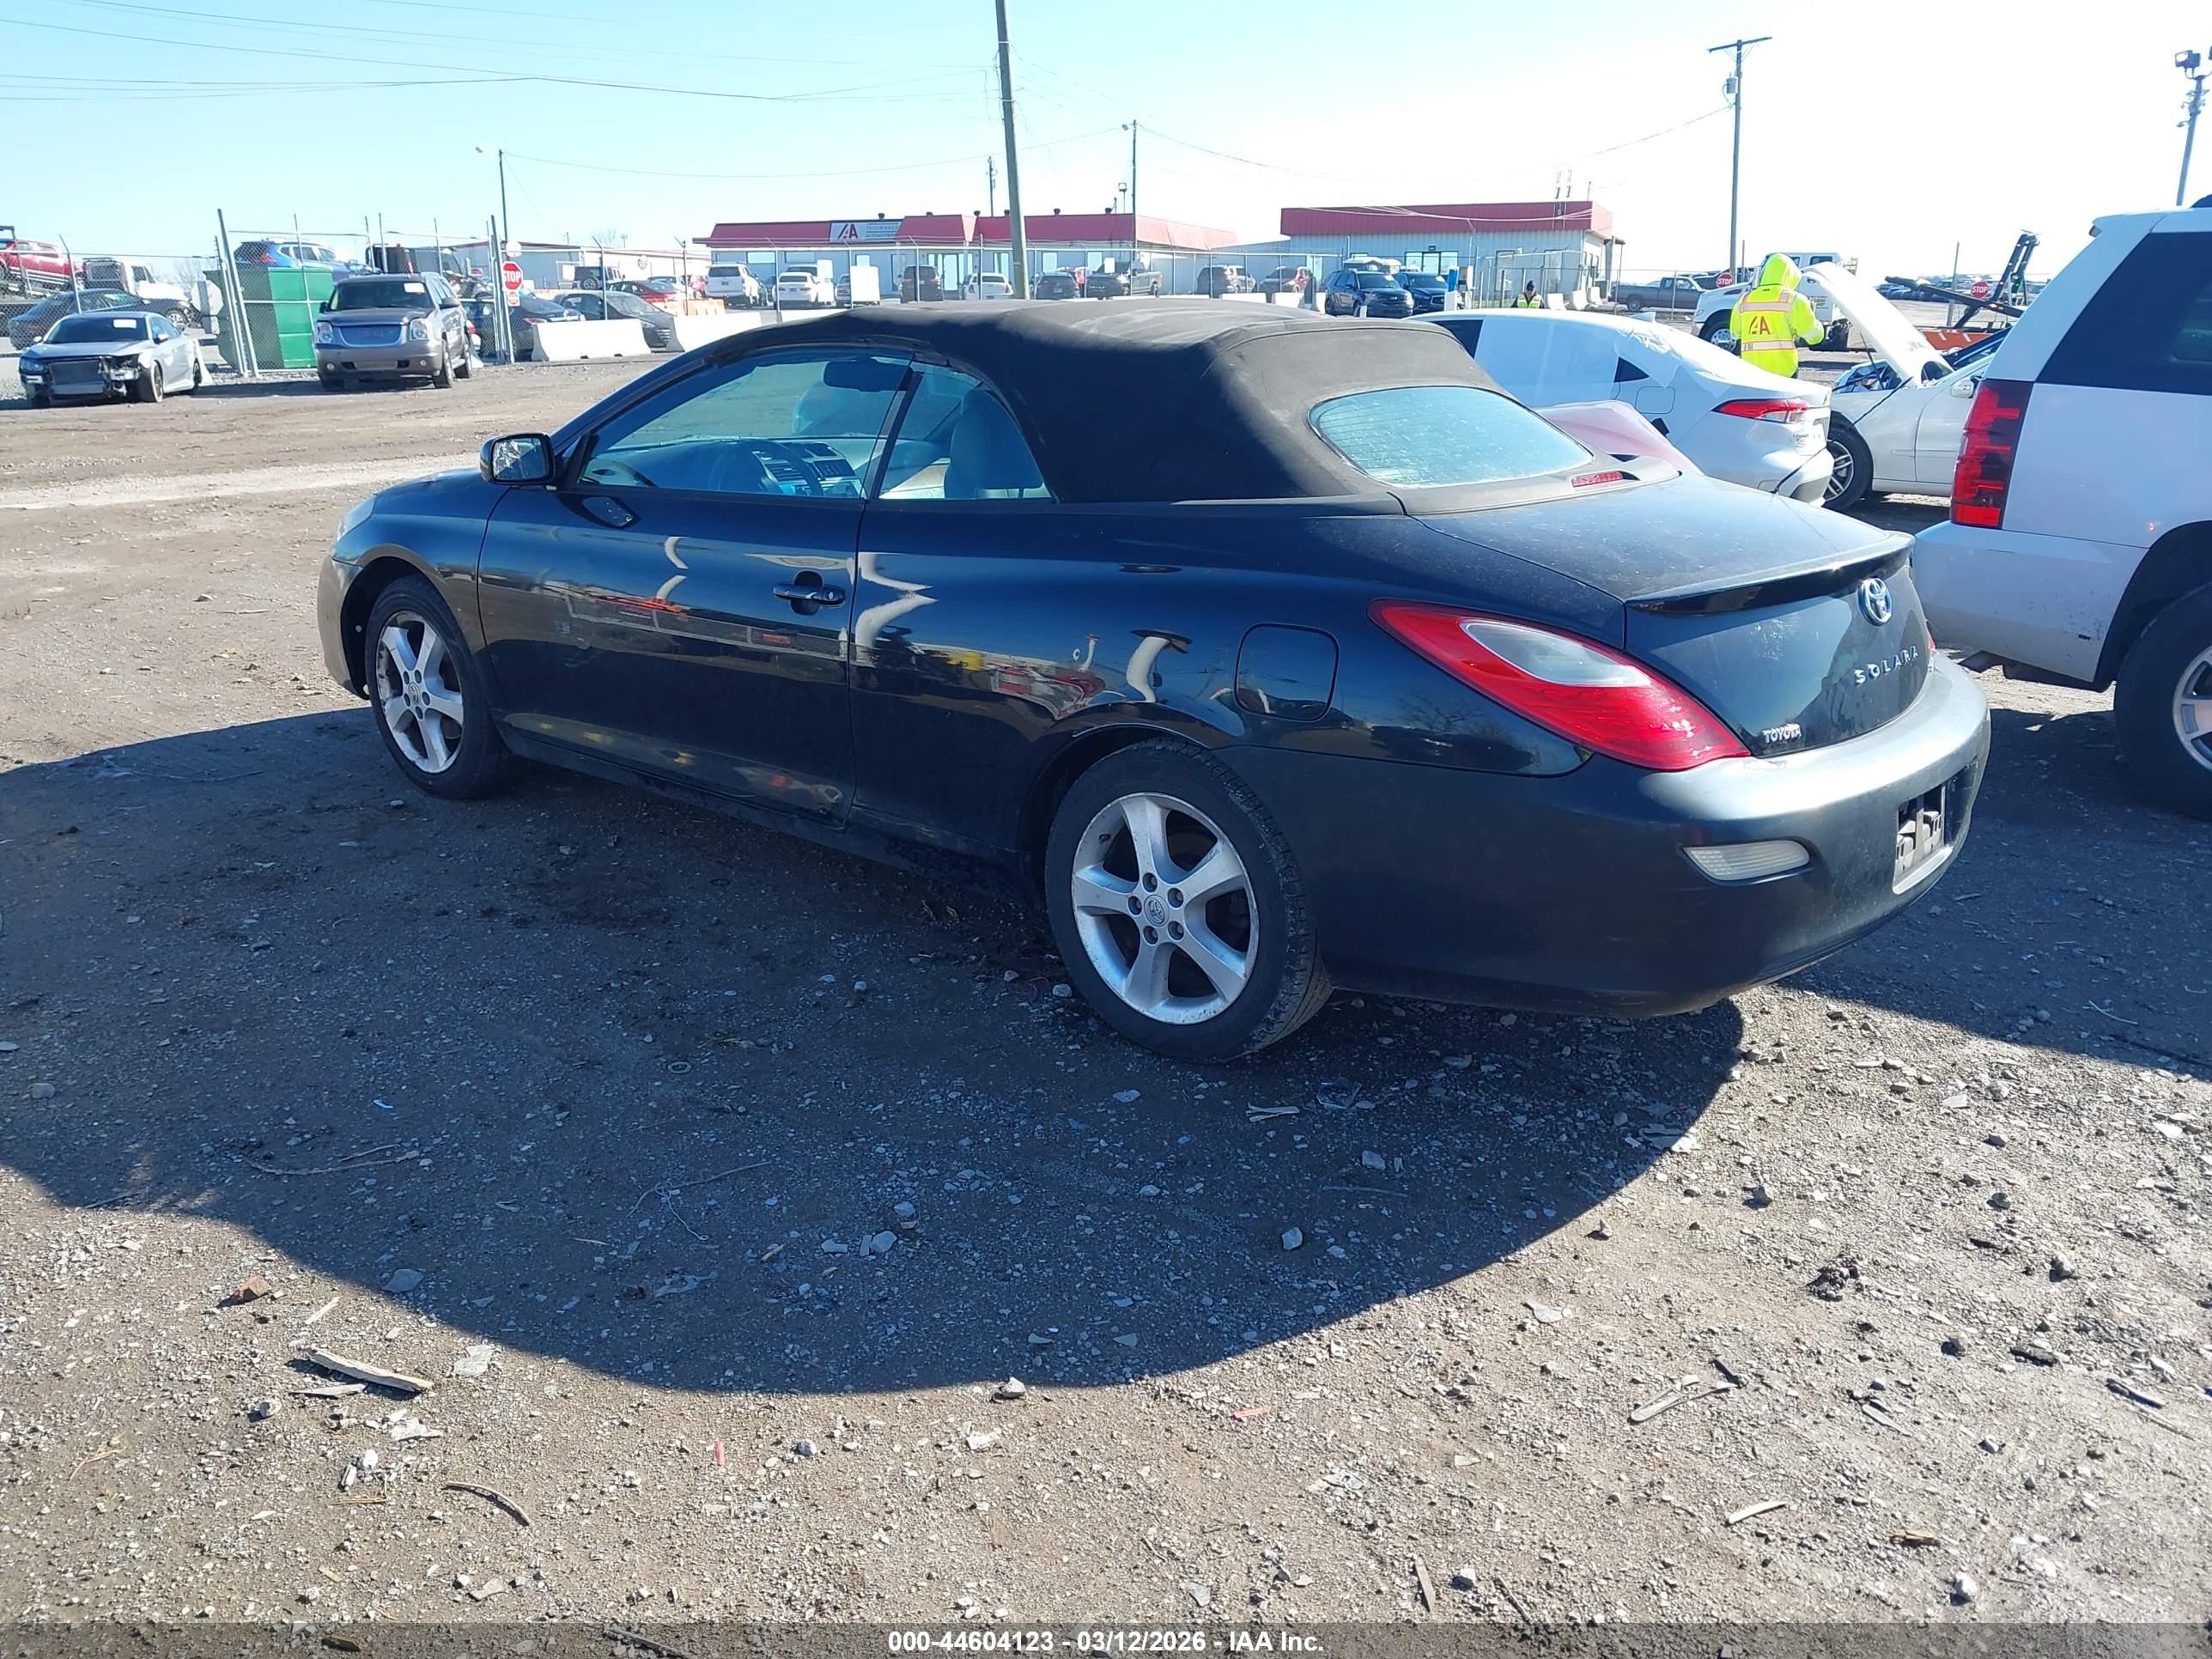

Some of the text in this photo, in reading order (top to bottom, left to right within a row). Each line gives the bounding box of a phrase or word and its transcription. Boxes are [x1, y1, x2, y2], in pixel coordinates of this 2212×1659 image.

[502, 270, 521, 283] STOP
[1855, 646, 1918, 685] SOLARA
[1762, 724, 1802, 744] TOYOTA
